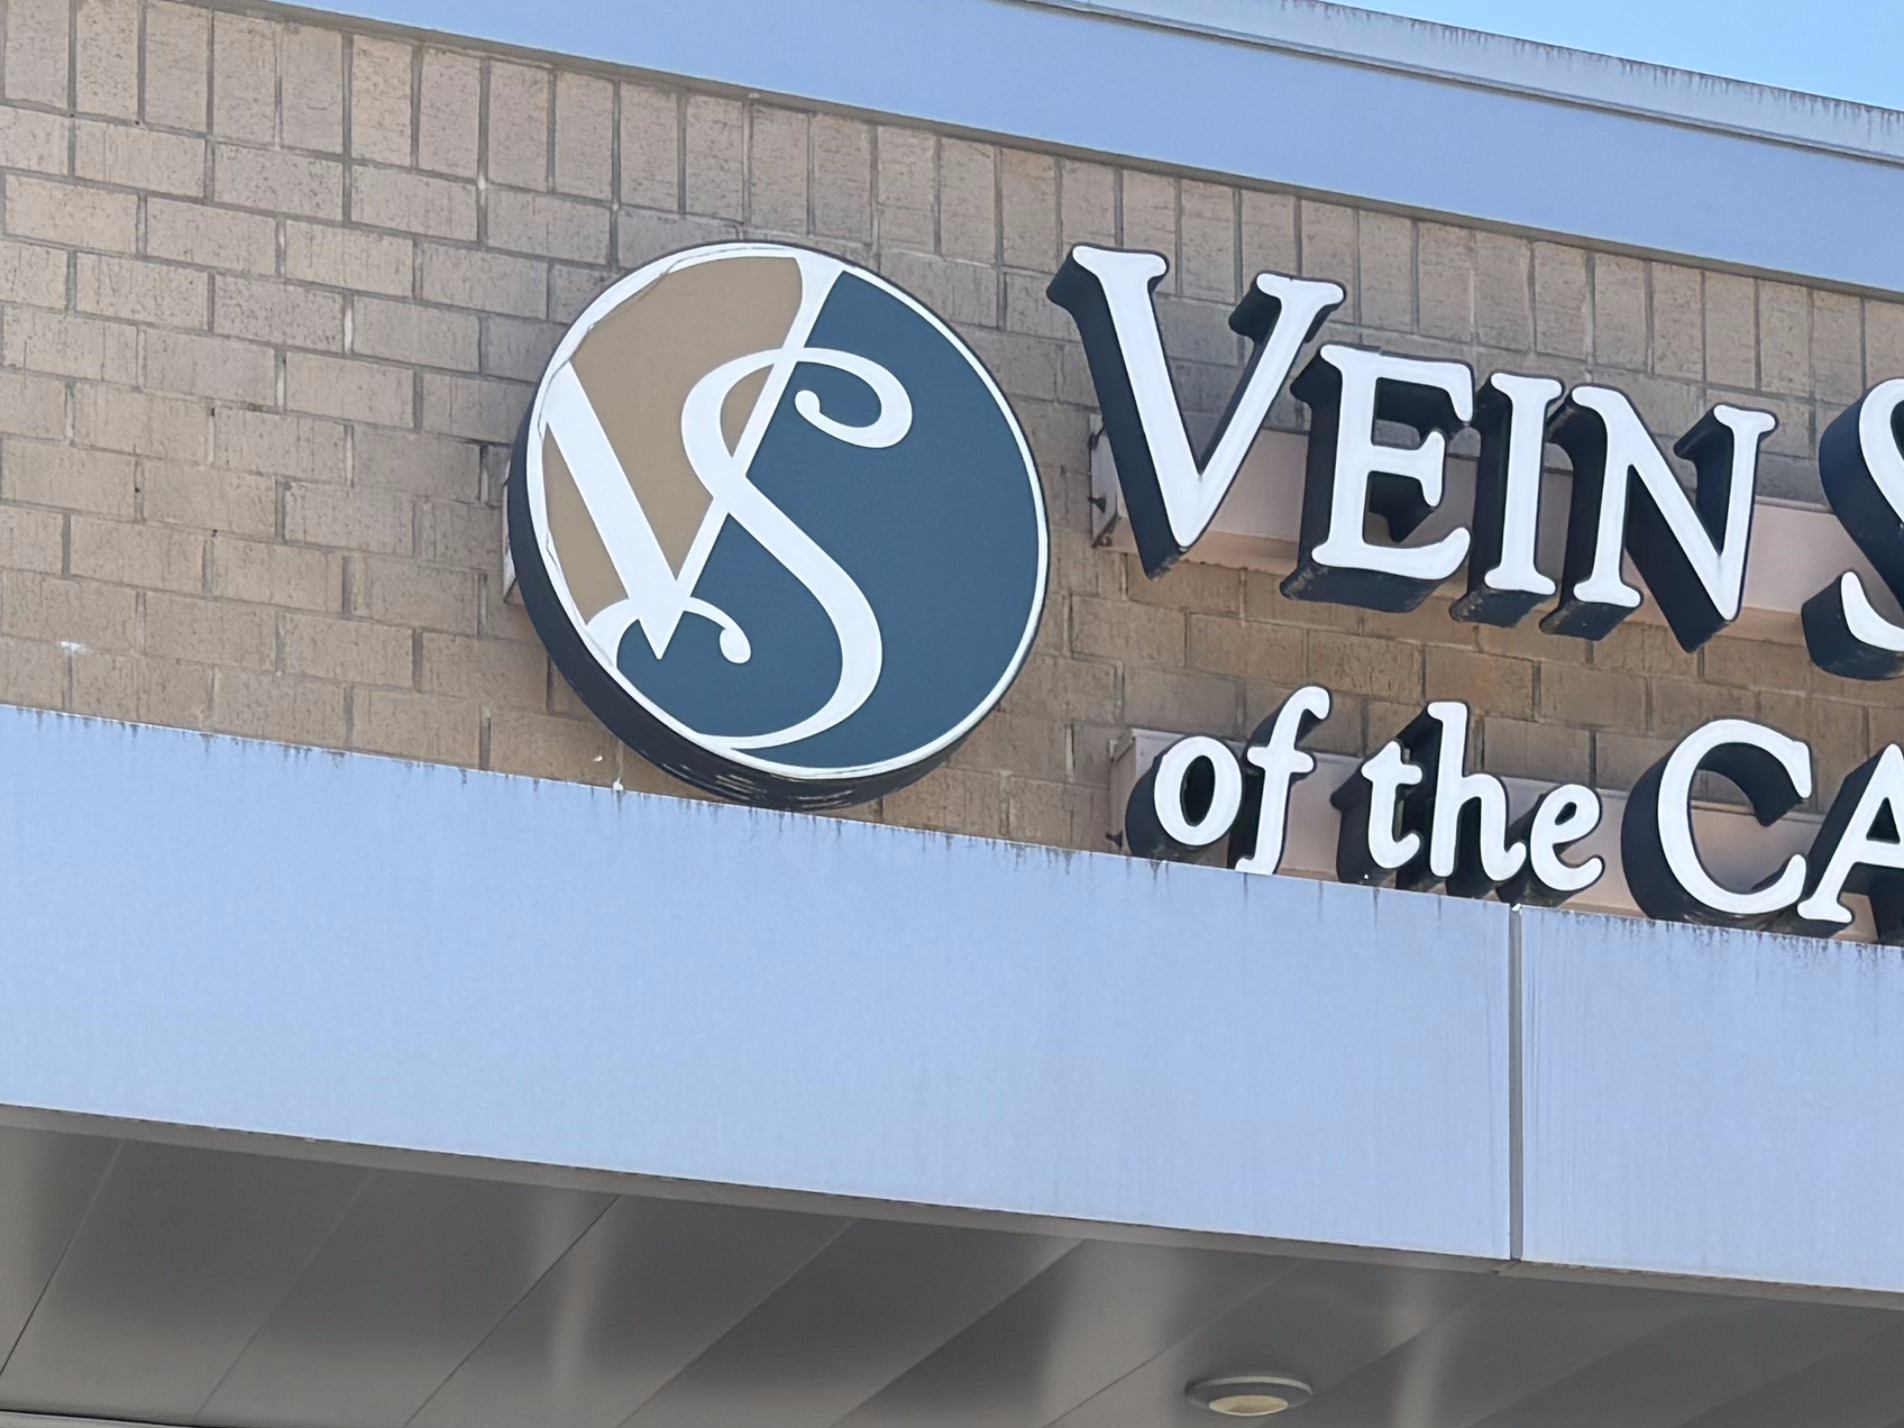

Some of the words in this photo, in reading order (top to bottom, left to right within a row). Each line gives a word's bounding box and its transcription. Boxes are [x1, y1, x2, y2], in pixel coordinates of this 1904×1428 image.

[1070, 244, 1778, 623] VEIN
[1152, 685, 1331, 875] of
[1361, 701, 1603, 891] the
